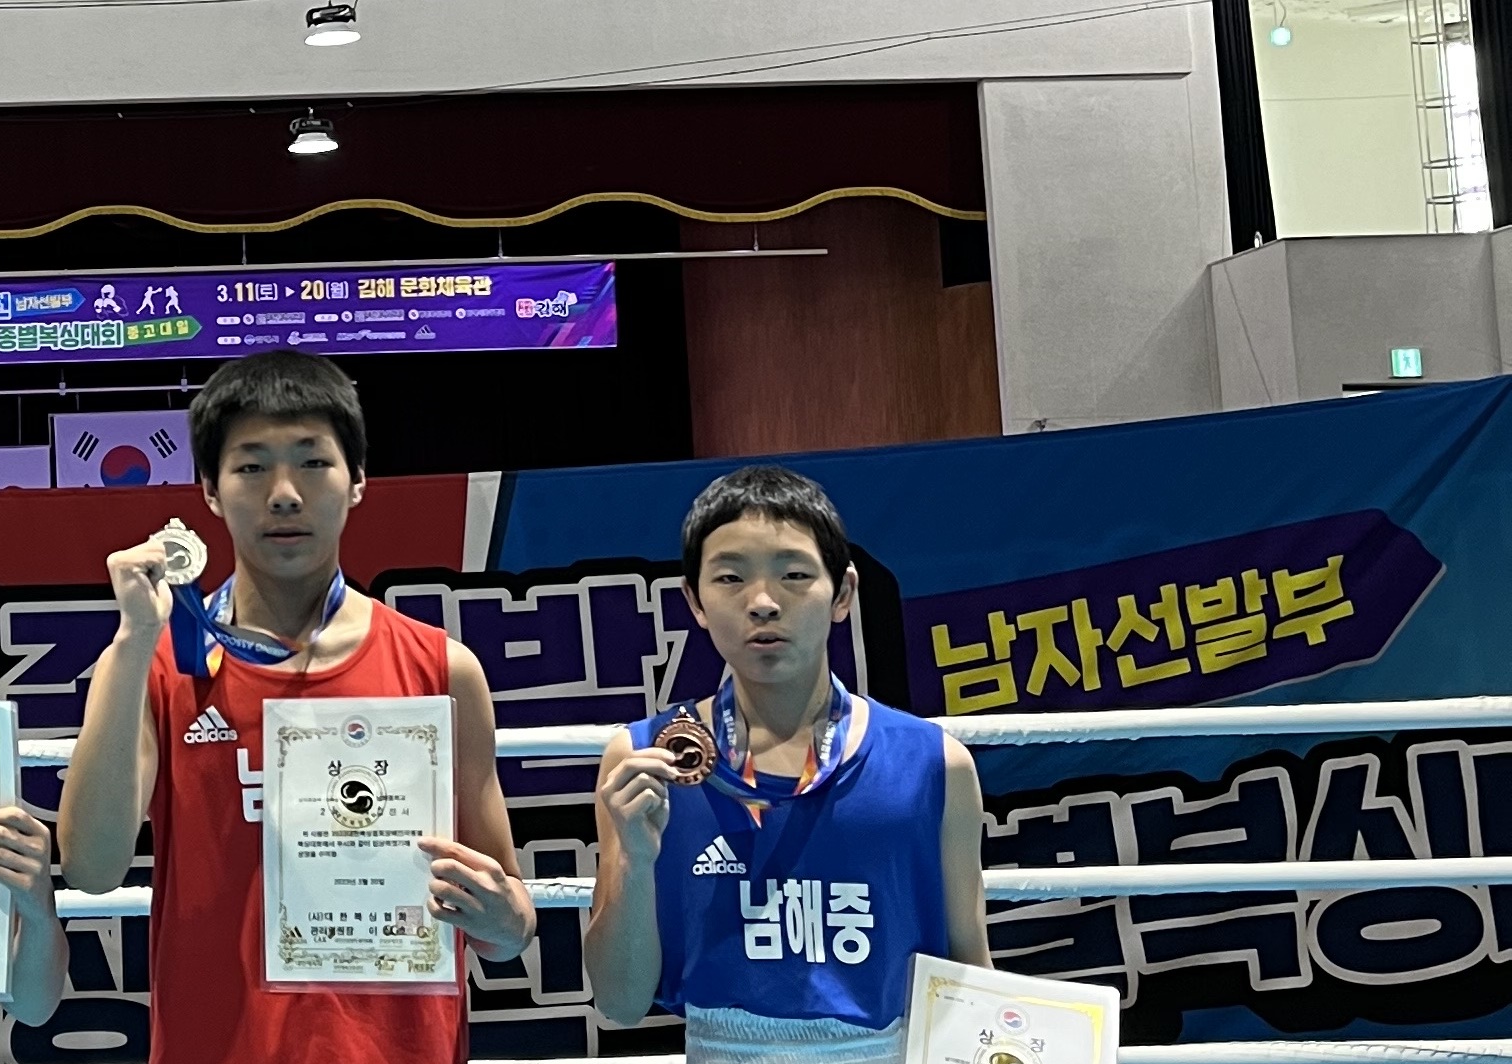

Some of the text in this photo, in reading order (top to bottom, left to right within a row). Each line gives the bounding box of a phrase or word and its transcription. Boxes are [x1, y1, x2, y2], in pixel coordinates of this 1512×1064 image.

[358, 278, 395, 299] 김해
[399, 275, 492, 298] 문화체육관
[931, 554, 1355, 717] 남자선발부
[184, 729, 238, 744] adidas
[328, 759, 389, 777] 상 장
[692, 860, 747, 876] adidas
[739, 878, 875, 965] 남해중
